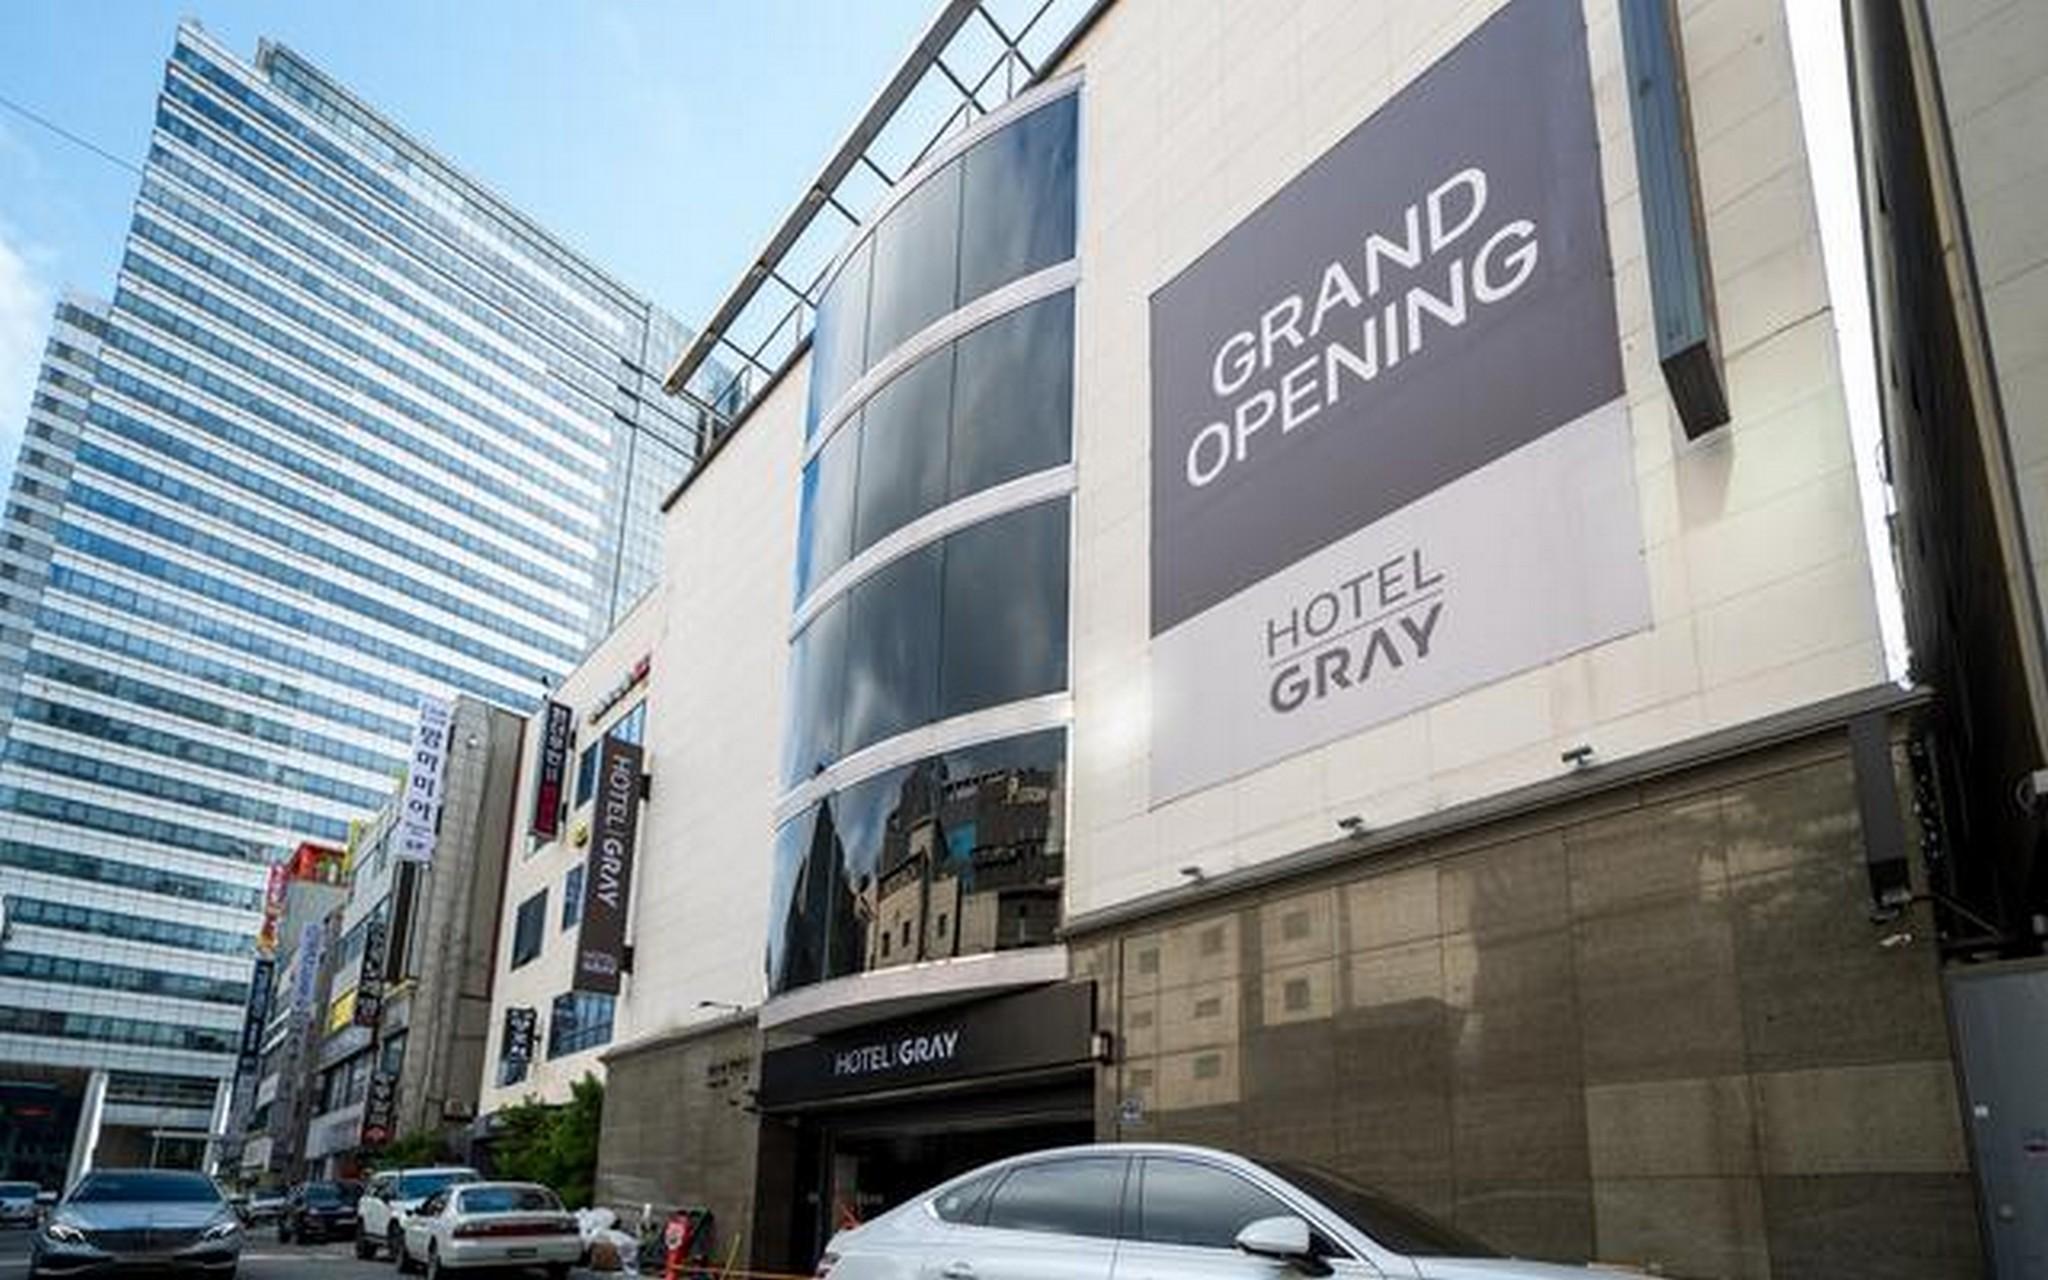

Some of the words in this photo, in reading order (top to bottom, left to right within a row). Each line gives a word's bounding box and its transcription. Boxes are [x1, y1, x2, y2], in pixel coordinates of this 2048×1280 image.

[1212, 167, 1487, 396] GRAND
[1187, 219, 1538, 487] OPENING
[1267, 548, 1444, 658] HOTEL
[1270, 602, 1443, 713] GRAY
[605, 754, 631, 825] HOTEL
[597, 838, 623, 909] GRAY
[834, 1044, 891, 1076] HOTEL
[899, 1030, 959, 1067] GRAY
